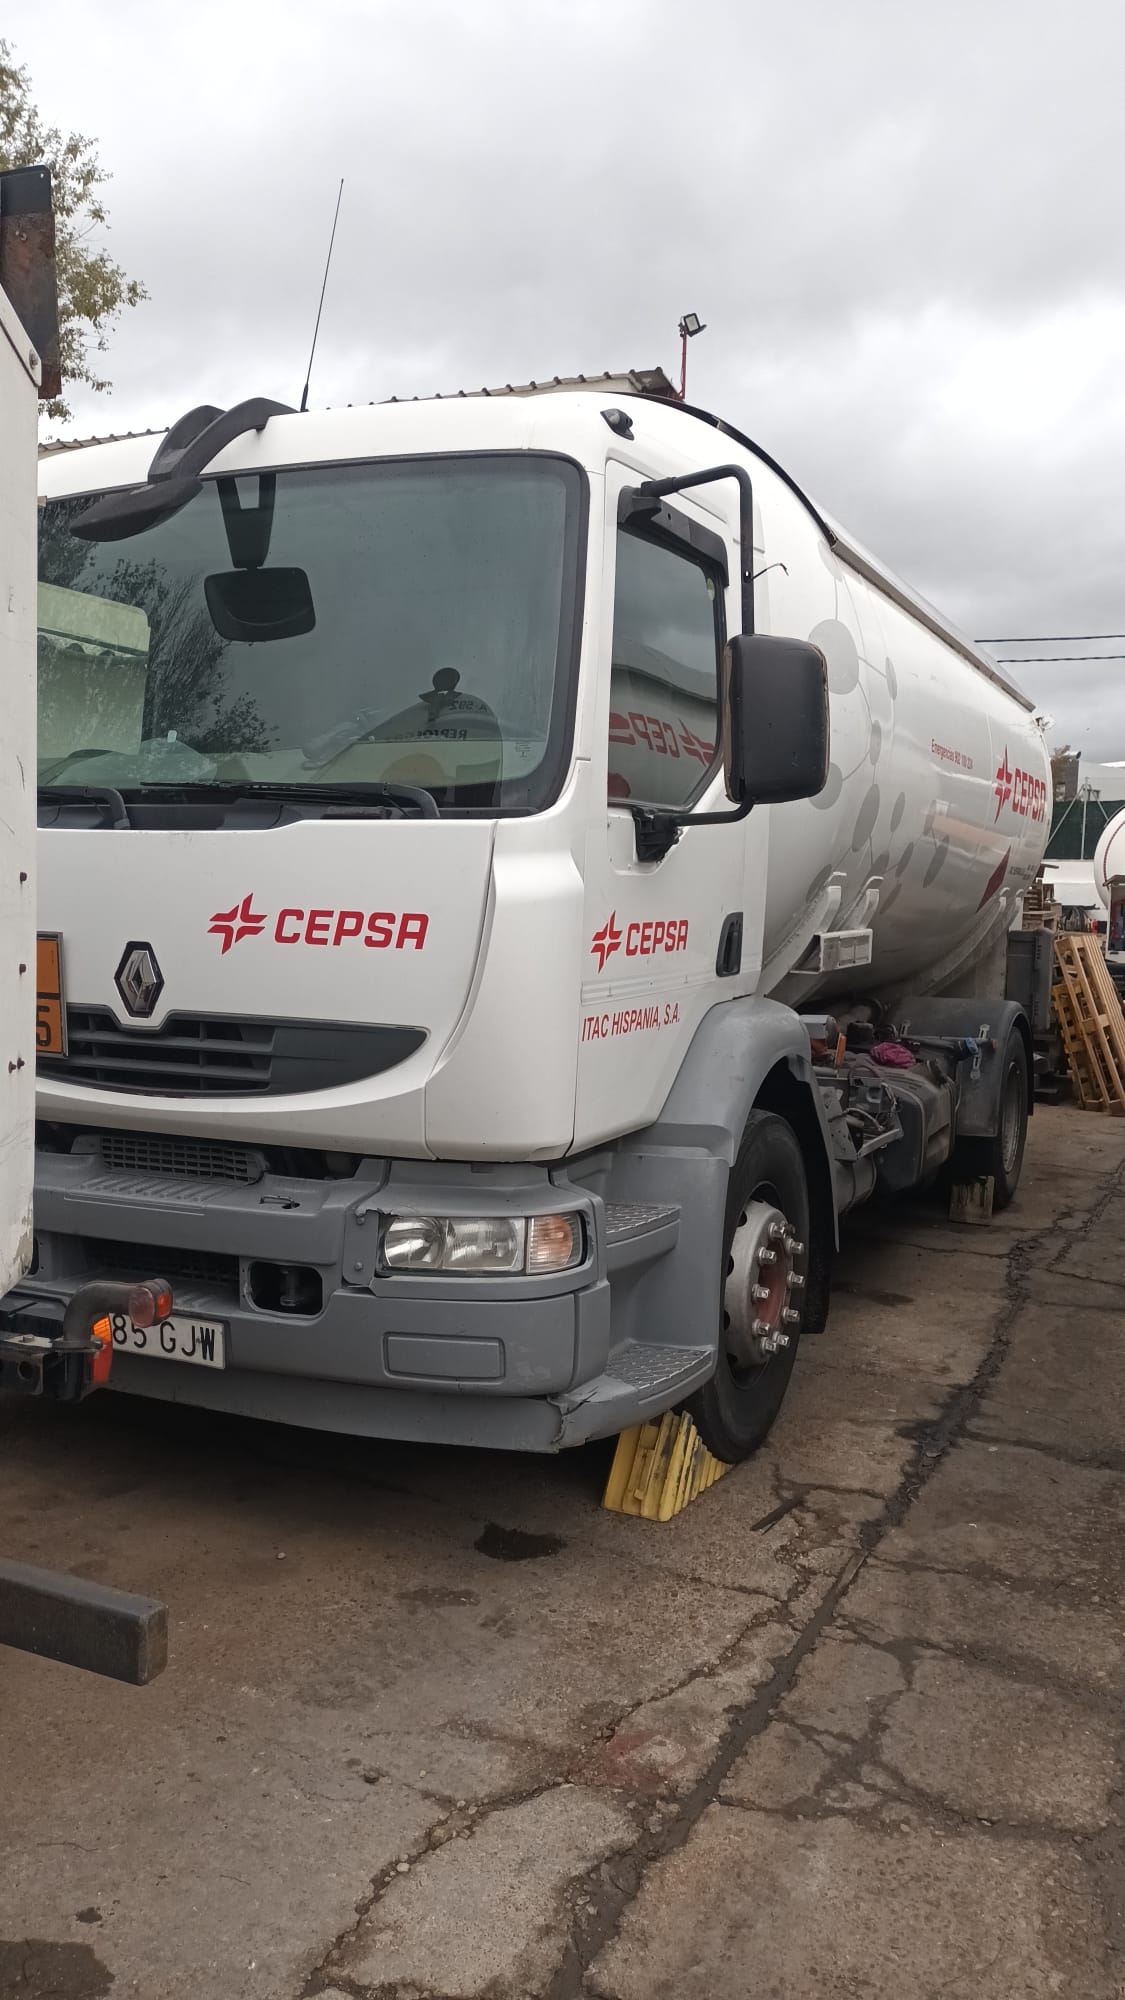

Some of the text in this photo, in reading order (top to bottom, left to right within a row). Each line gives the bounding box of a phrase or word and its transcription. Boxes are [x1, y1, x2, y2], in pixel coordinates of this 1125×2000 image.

[1011, 768, 1047, 823] CEPSA
[274, 908, 429, 950] CEPSA
[625, 920, 688, 957] CEPSA
[582, 1003, 680, 1042] ITAC HISPANIA, S.A.
[160, 1321, 215, 1361] GJW
